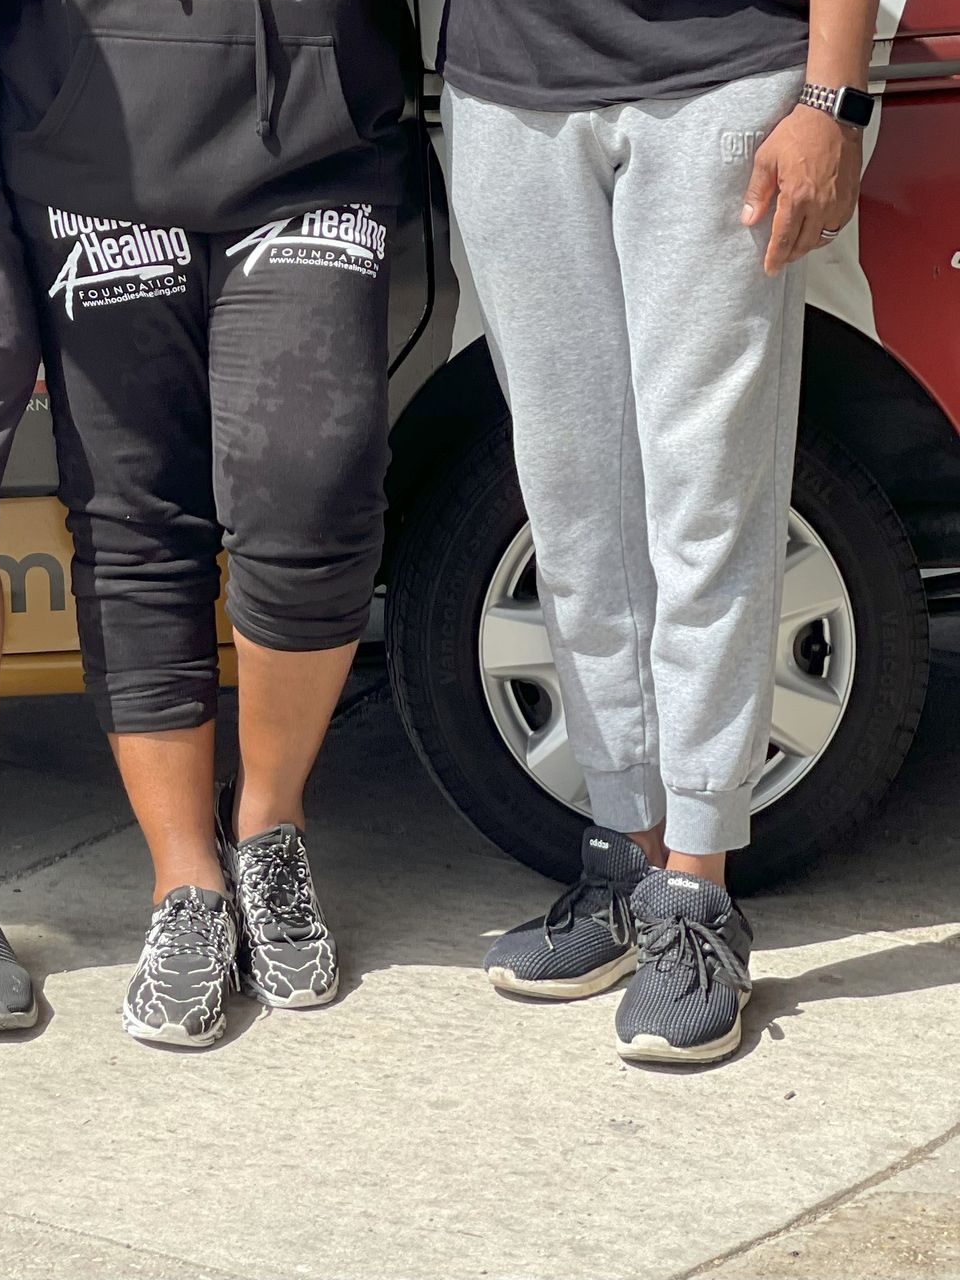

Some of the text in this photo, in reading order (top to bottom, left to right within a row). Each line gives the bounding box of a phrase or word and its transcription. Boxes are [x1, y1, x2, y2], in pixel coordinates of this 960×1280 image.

[80, 223, 192, 273] Healing
[225, 208, 388, 277] 4 Healing
[269, 256, 377, 279] www.hoodies4healing.org
[270, 248, 380, 271] FOUNDATION
[48, 240, 174, 321] 4
[78, 274, 188, 300] FOUNDATION
[589, 838, 609, 849] adidas
[667, 877, 700, 890] adidas
